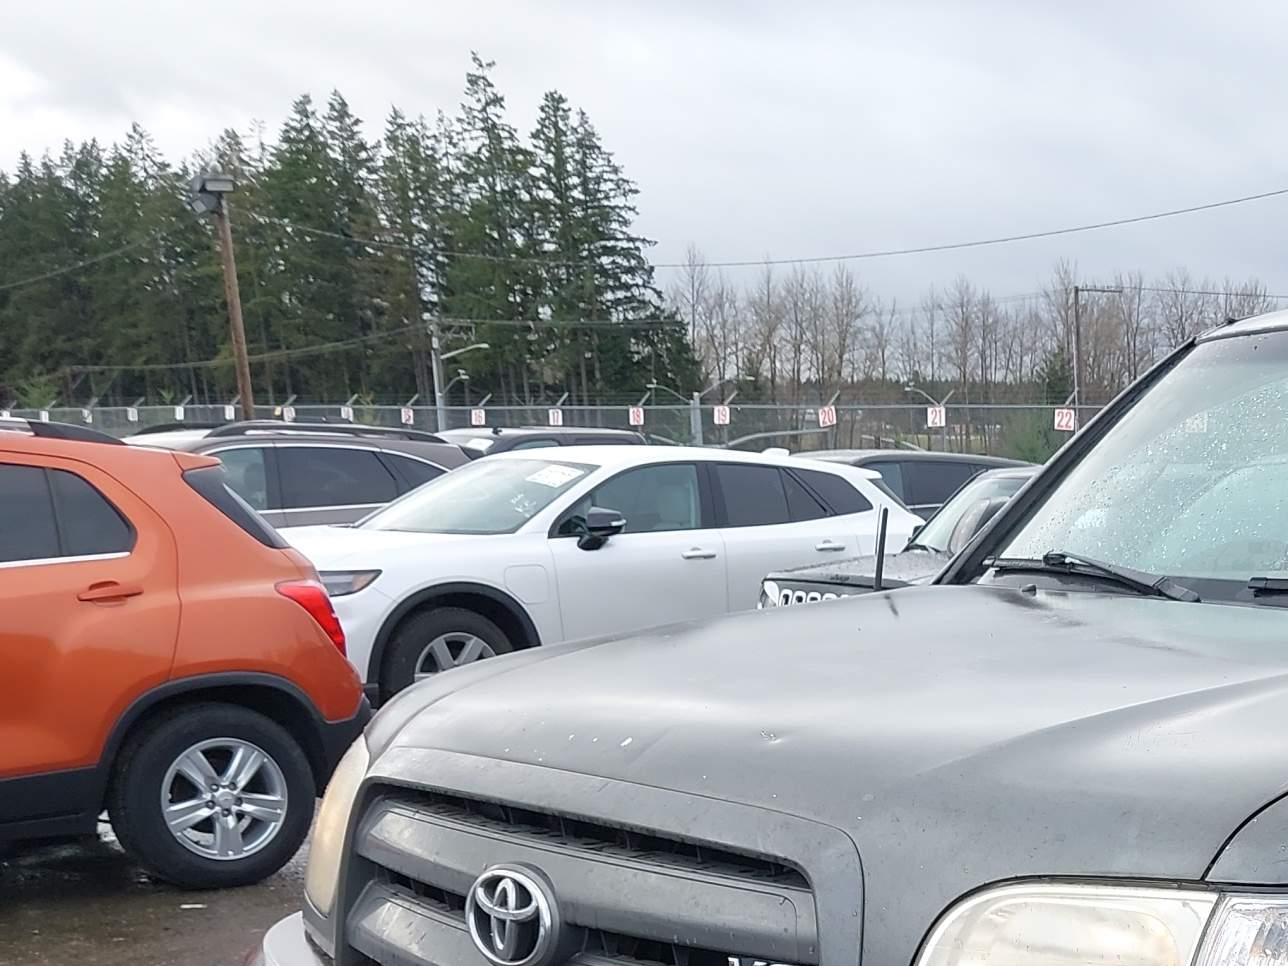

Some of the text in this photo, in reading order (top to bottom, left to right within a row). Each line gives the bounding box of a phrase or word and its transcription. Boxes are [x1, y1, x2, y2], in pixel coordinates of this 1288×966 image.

[717, 407, 727, 423] 19
[820, 407, 834, 426] 20
[930, 408, 943, 426] 21
[1056, 411, 1073, 429] 22
